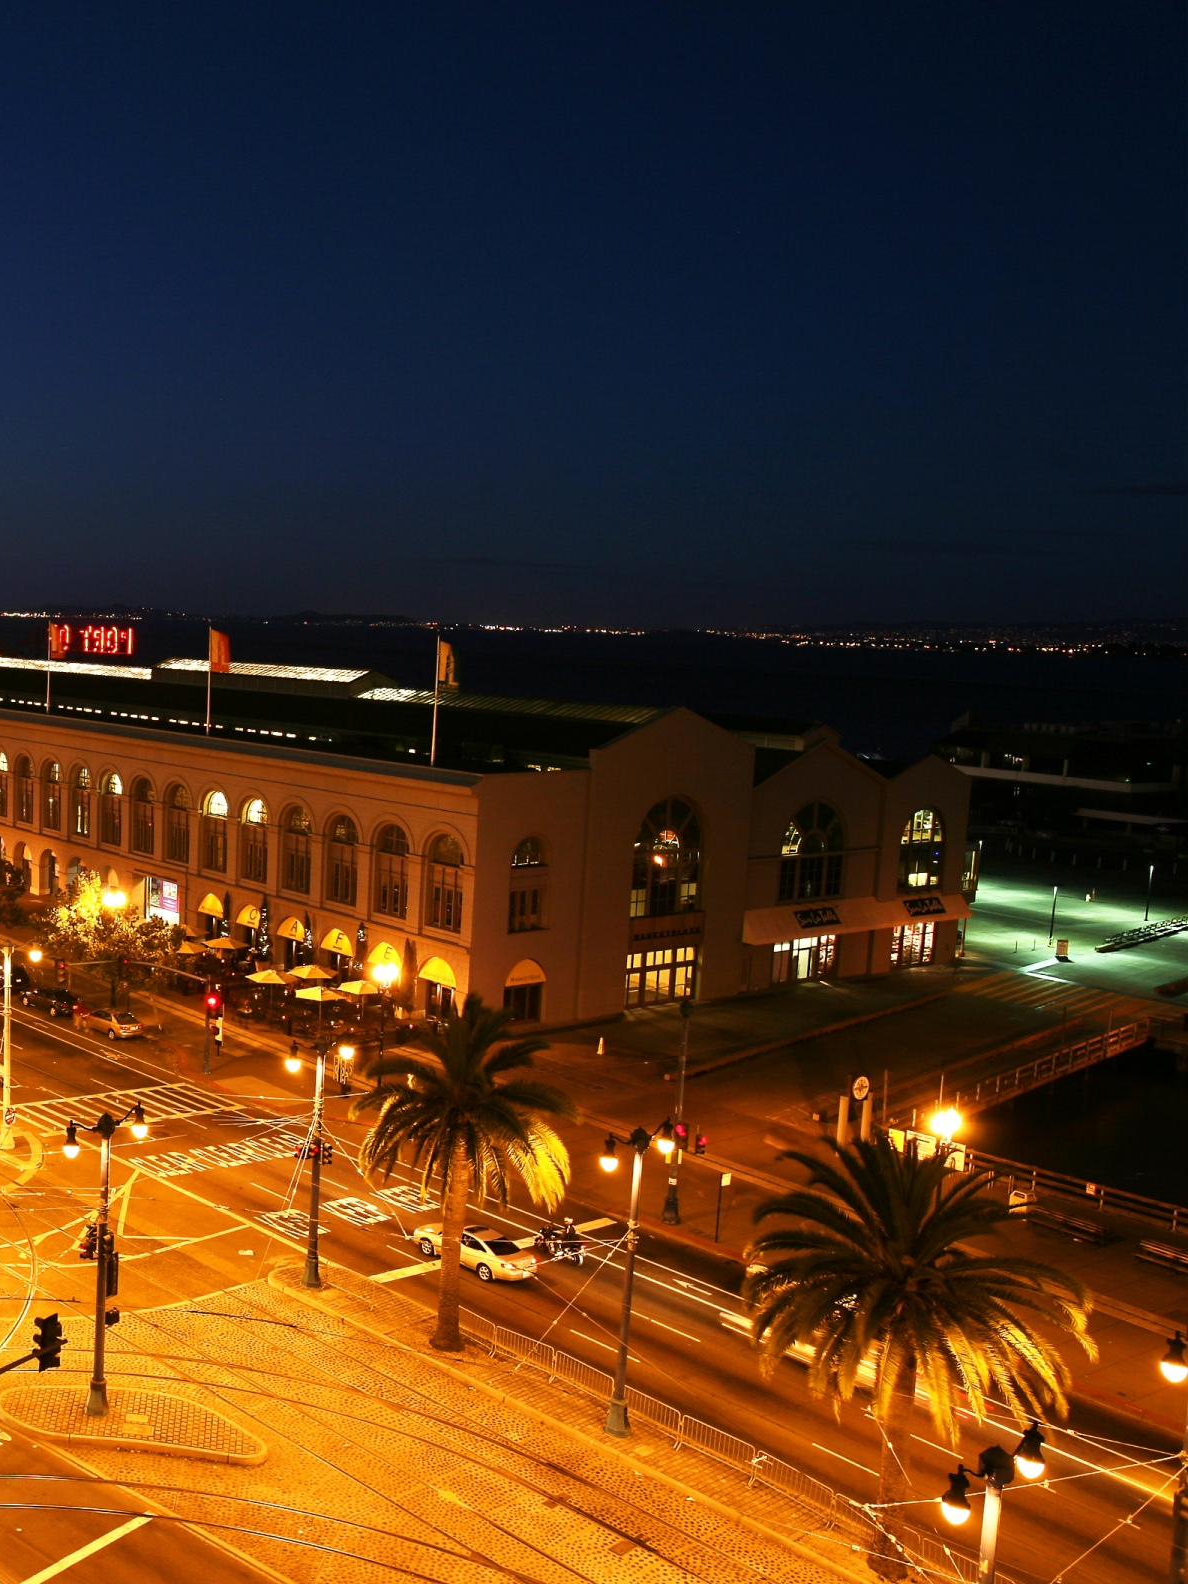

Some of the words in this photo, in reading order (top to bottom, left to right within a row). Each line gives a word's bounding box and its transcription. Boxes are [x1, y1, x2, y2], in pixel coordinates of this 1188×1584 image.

[128, 1151, 214, 1178] CLEAR
[188, 1142, 273, 1168] CLEAR
[318, 1196, 393, 1226] KEEP
[369, 1185, 442, 1214] KEEP
